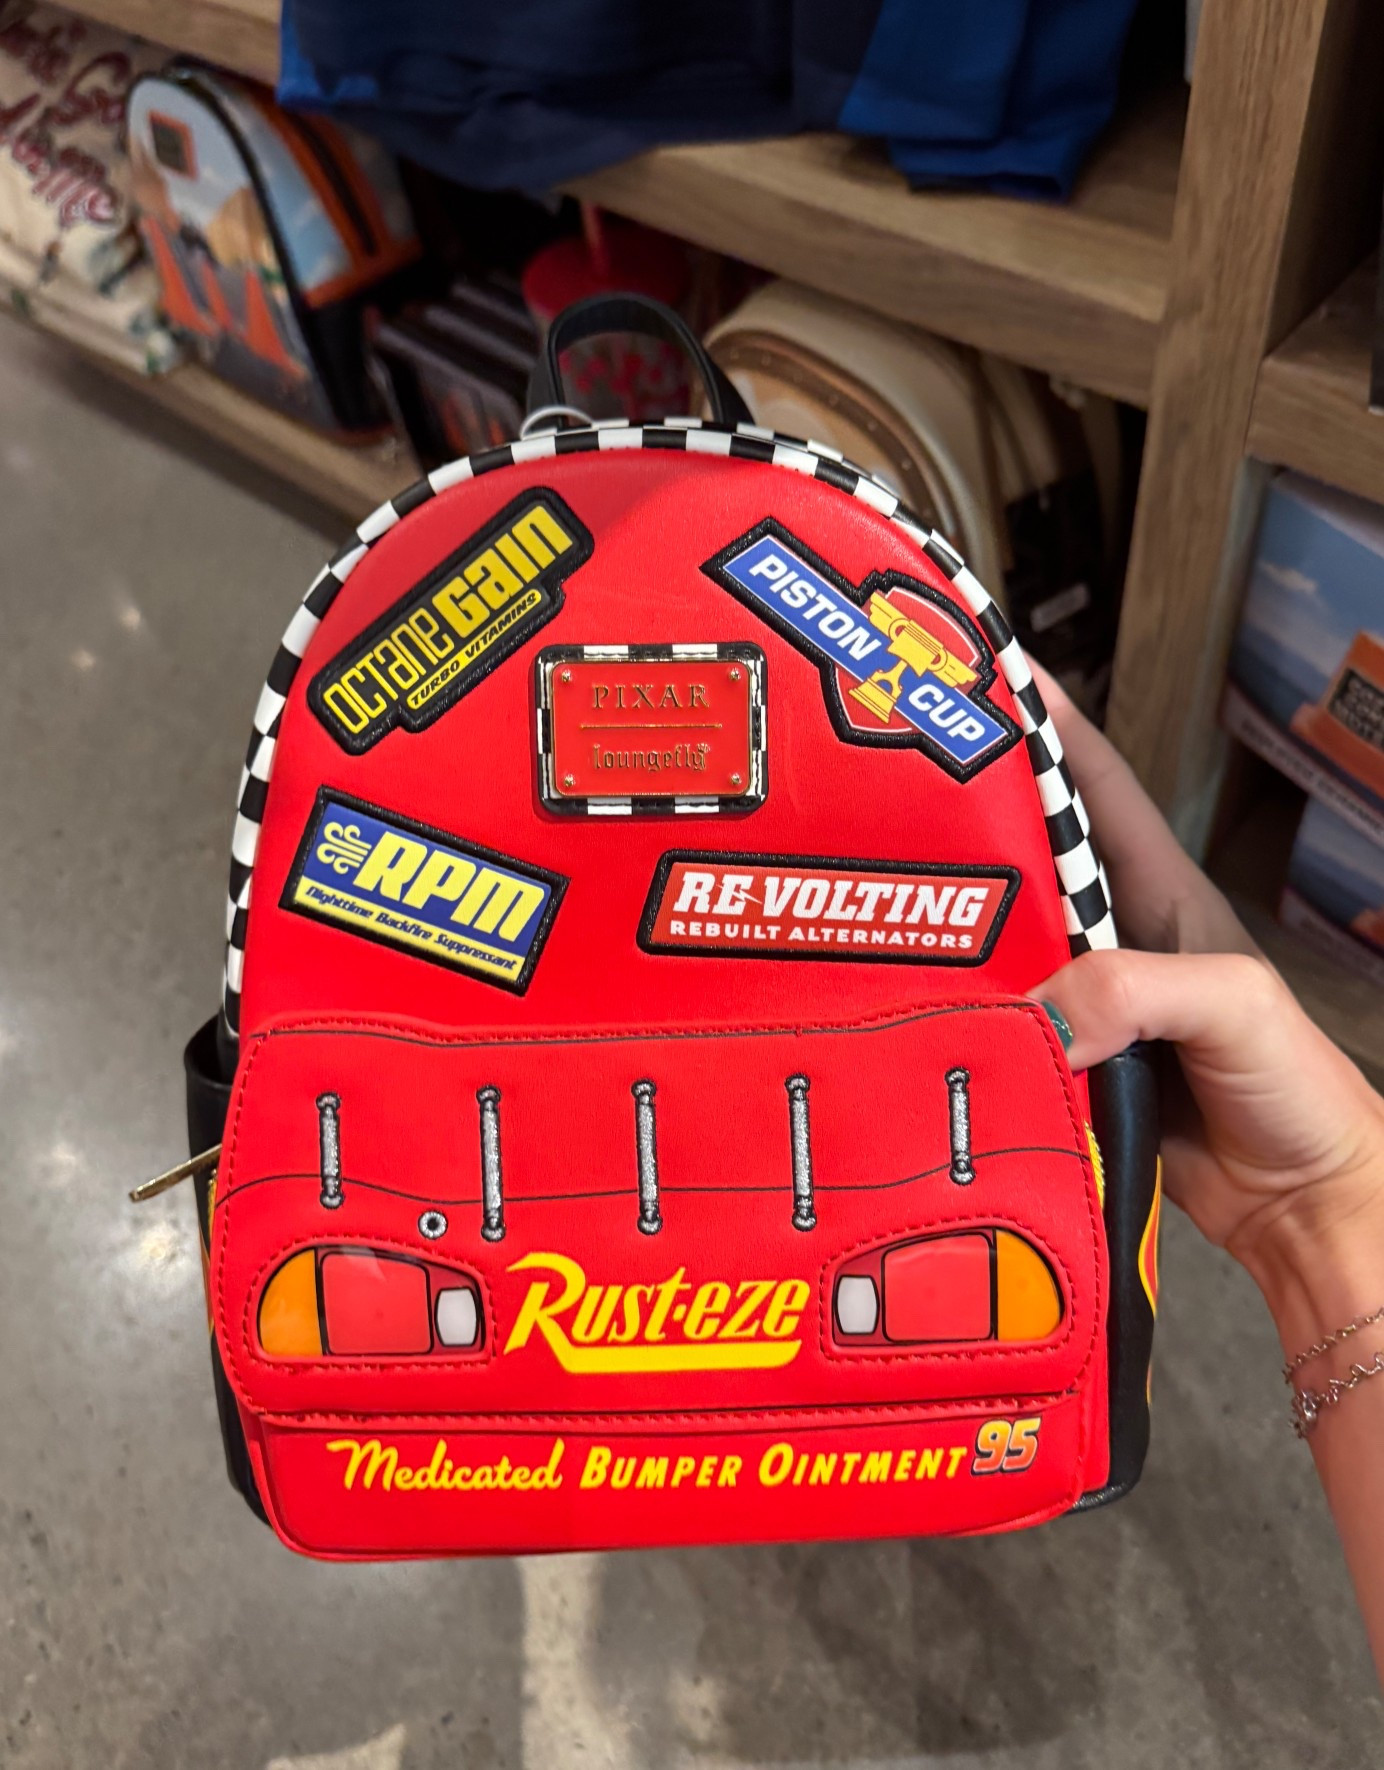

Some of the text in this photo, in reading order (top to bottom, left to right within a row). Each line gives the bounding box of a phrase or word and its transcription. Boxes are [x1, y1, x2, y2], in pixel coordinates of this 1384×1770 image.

[410, 592, 538, 707] TURBO VITAMINS
[748, 554, 986, 742] PISTON CUP
[592, 683, 711, 709] PIXAR
[592, 743, 708, 772] loungefly
[352, 830, 545, 943] RPM
[305, 885, 518, 972] Nighttime Backfire Suppressant
[670, 919, 974, 949] REBUILT ALTERNATORS
[325, 1437, 566, 1492] Medicated
[970, 1415, 1043, 1477] 95
